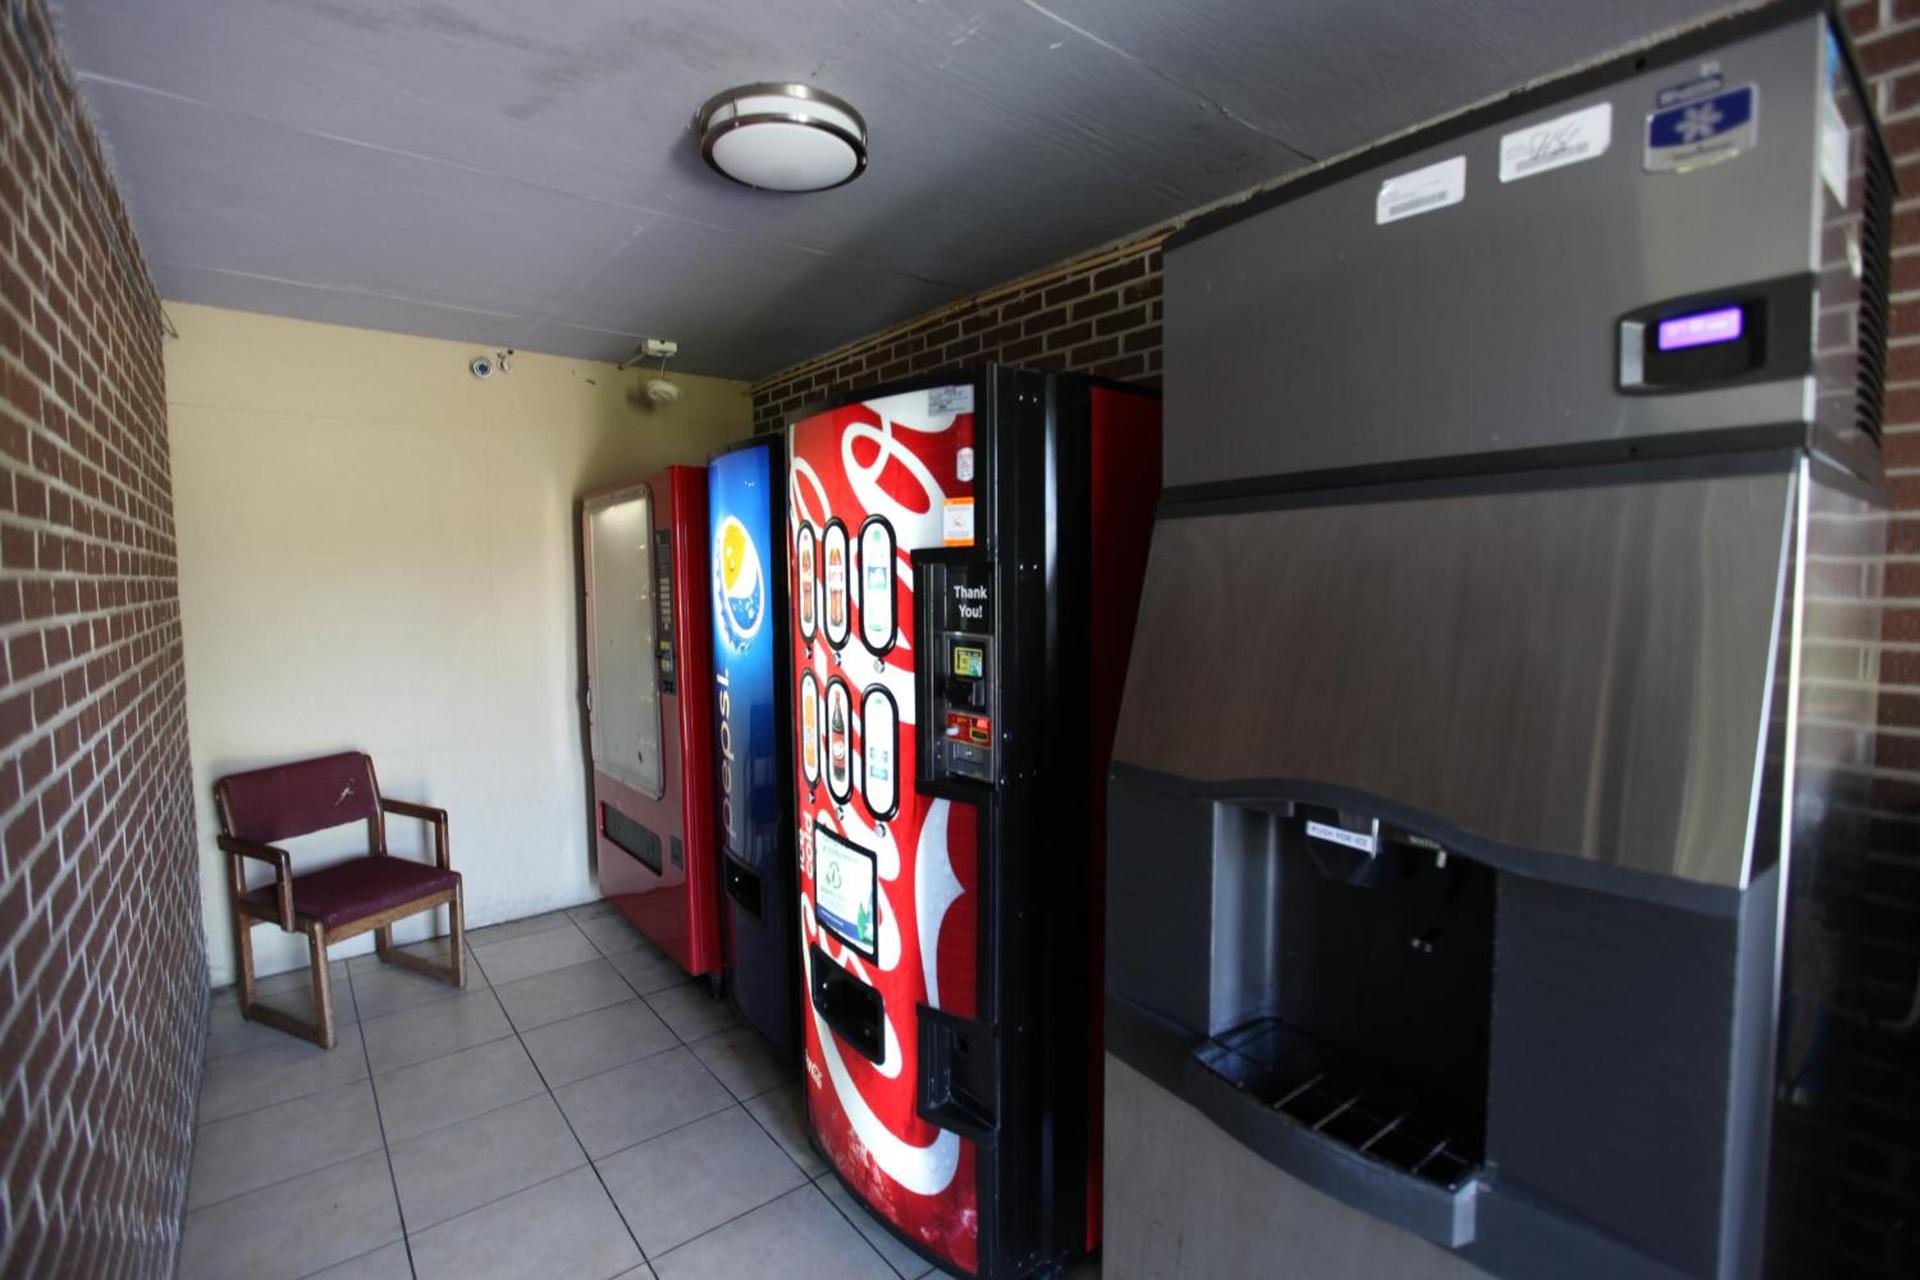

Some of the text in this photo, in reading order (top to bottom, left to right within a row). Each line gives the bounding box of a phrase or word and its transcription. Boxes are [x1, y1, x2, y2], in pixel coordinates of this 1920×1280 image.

[954, 585, 987, 599] Thank
[958, 604, 983, 618] You!
[717, 667, 736, 840] pepsi
